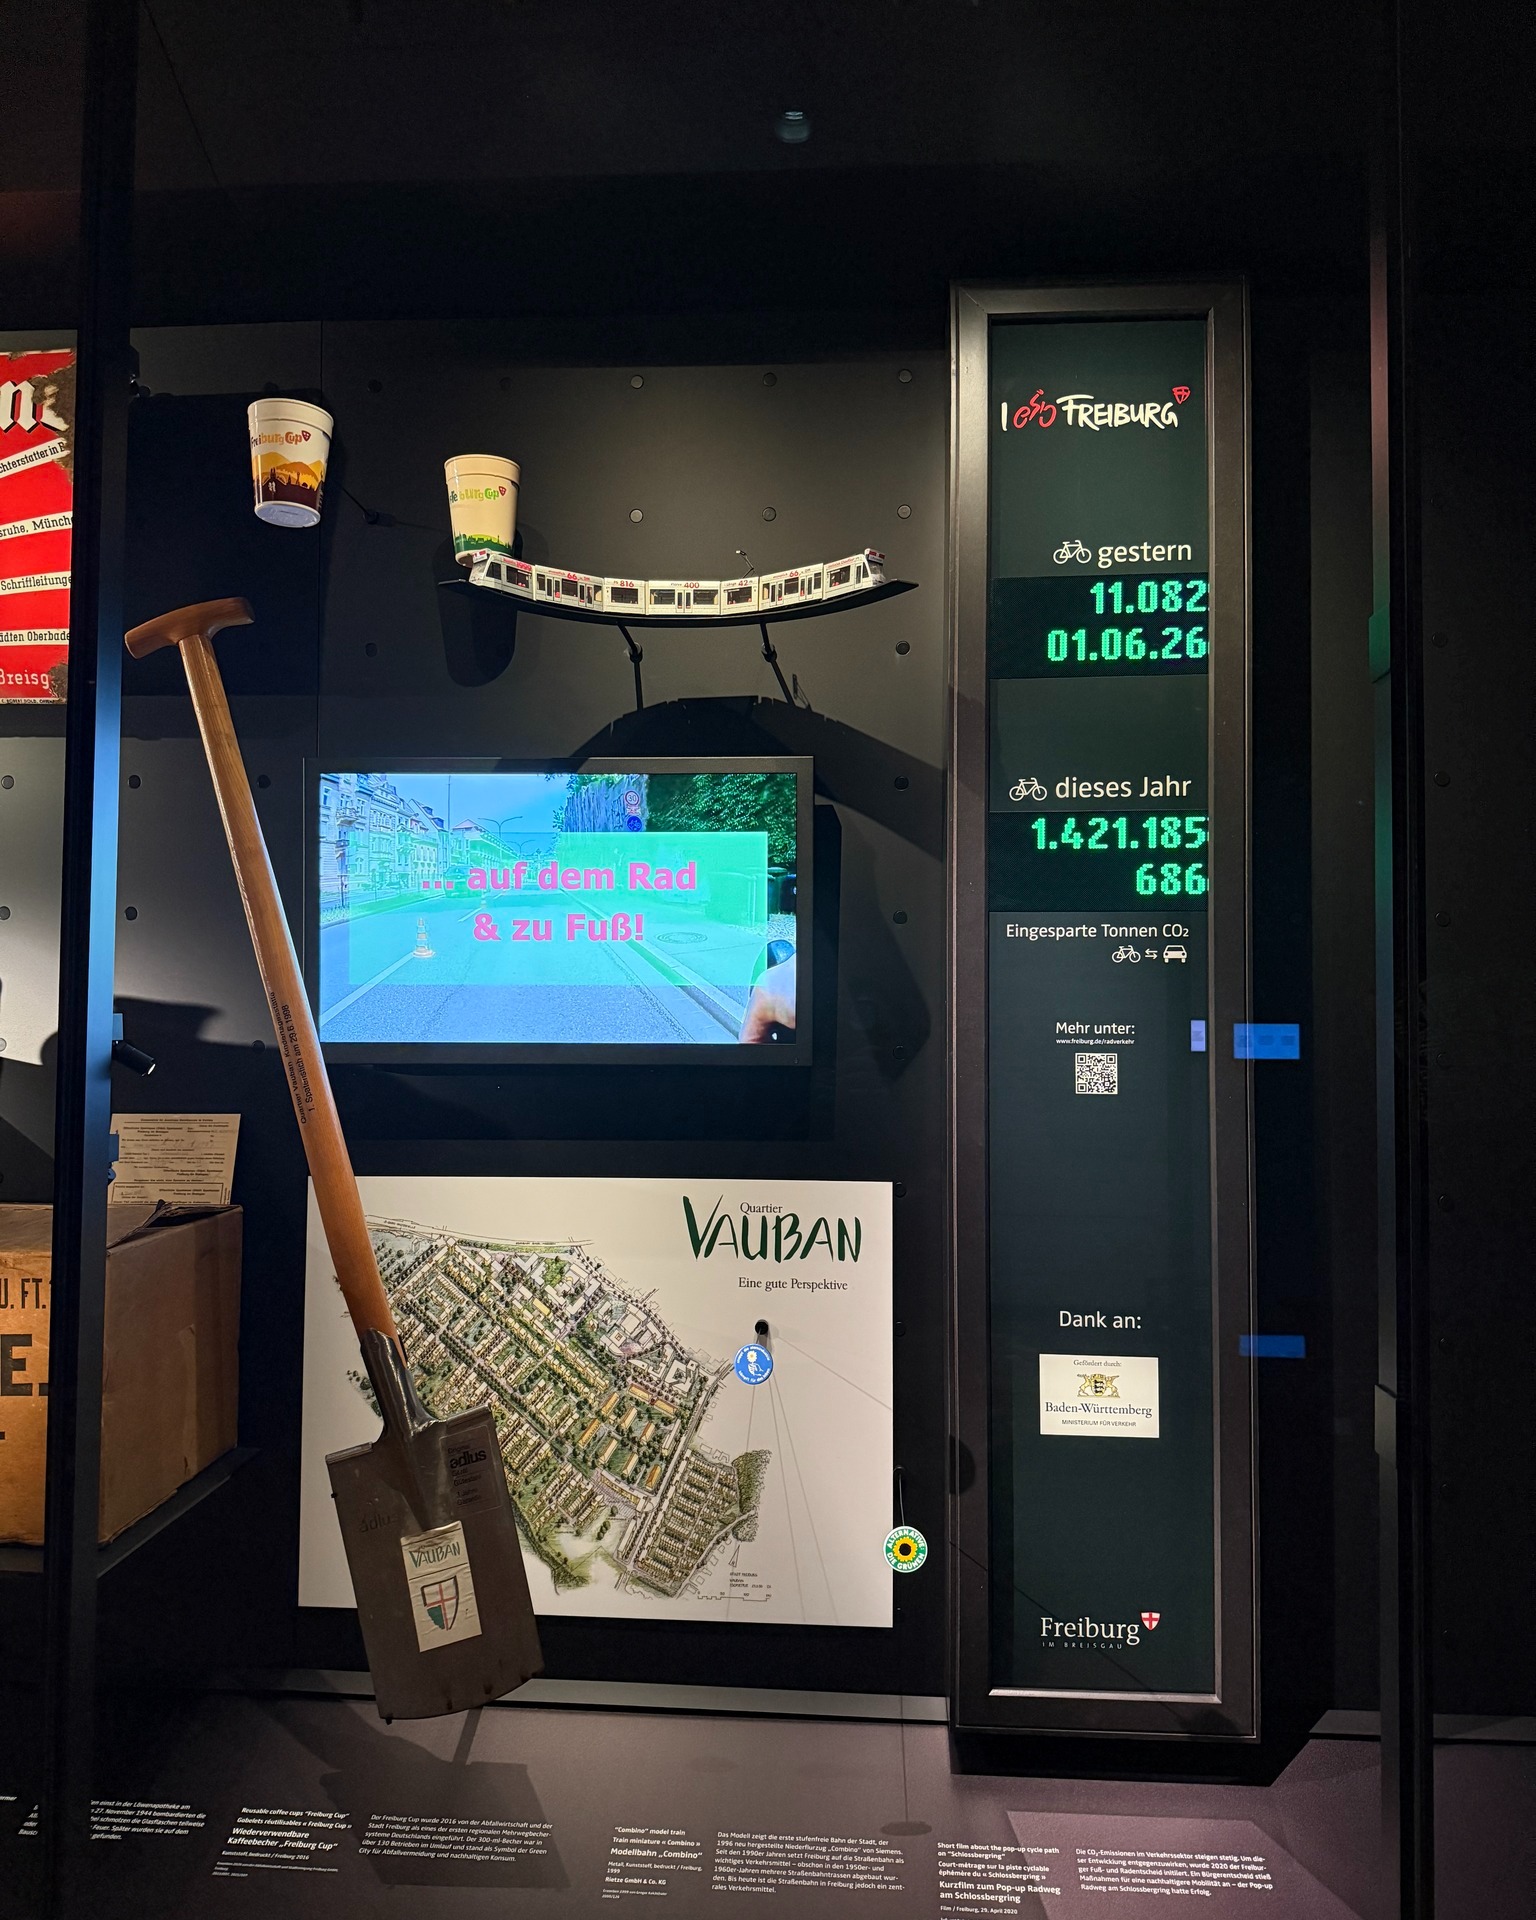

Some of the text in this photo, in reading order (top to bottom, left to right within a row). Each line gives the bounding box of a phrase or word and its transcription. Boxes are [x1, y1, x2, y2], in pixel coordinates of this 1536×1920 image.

[1001, 394, 1178, 431] I FREIBURG
[1098, 541, 1192, 569] gestern
[567, 572, 578, 581] 66
[620, 580, 635, 588] 816
[1090, 580, 1207, 614] 11.082
[1047, 627, 1207, 661] 01.06.26
[1055, 776, 1191, 799] dieses Jahr
[1031, 817, 1206, 850] 1.421.185
[467, 861, 527, 891] auf
[537, 861, 614, 891] dem
[628, 861, 697, 891] Rad
[1136, 863, 1207, 896] 686
[473, 913, 645, 941] & zu Fuß!
[1006, 923, 1097, 942] Eingesparte
[1101, 923, 1158, 938] Tonnen
[1056, 1021, 1136, 1035] Mehr unter:
[293, 1043, 301, 1057] am
[740, 1202, 783, 1216] Quartier
[682, 1194, 862, 1264] VAUBAN
[738, 1277, 848, 1292] Eine gute Perspektive
[21, 1278, 47, 1309] FT.
[1059, 1310, 1142, 1330] Dank an:
[1073, 1359, 1103, 1367] Gefördert
[1045, 1401, 1153, 1418] Baden-Württemberg
[408, 1541, 461, 1568] VAUBAN
[887, 1552, 925, 1570] DIE GRÜNEN
[1040, 1617, 1140, 1646] Freiburg
[1064, 1641, 1122, 1649] BREISGAU
[264, 1818, 301, 1826] réutilisables
[481, 1820, 528, 1828] Abfallwirtschaft
[232, 1828, 309, 1838] Wiederverwendbare
[227, 1837, 279, 1847] Kaffeebecher
[611, 1848, 657, 1857] Modellbahn
[989, 1871, 1040, 1880] Schlossbergring
[939, 1881, 974, 1890] Kurzfilm
[996, 1883, 1026, 1893] Pop-up
[1028, 1885, 1061, 1895] Radweg
[1081, 1884, 1106, 1892] Radweg
[1120, 1886, 1170, 1895] Schlossbergring
[955, 1892, 1021, 1903] Schlossbergring
